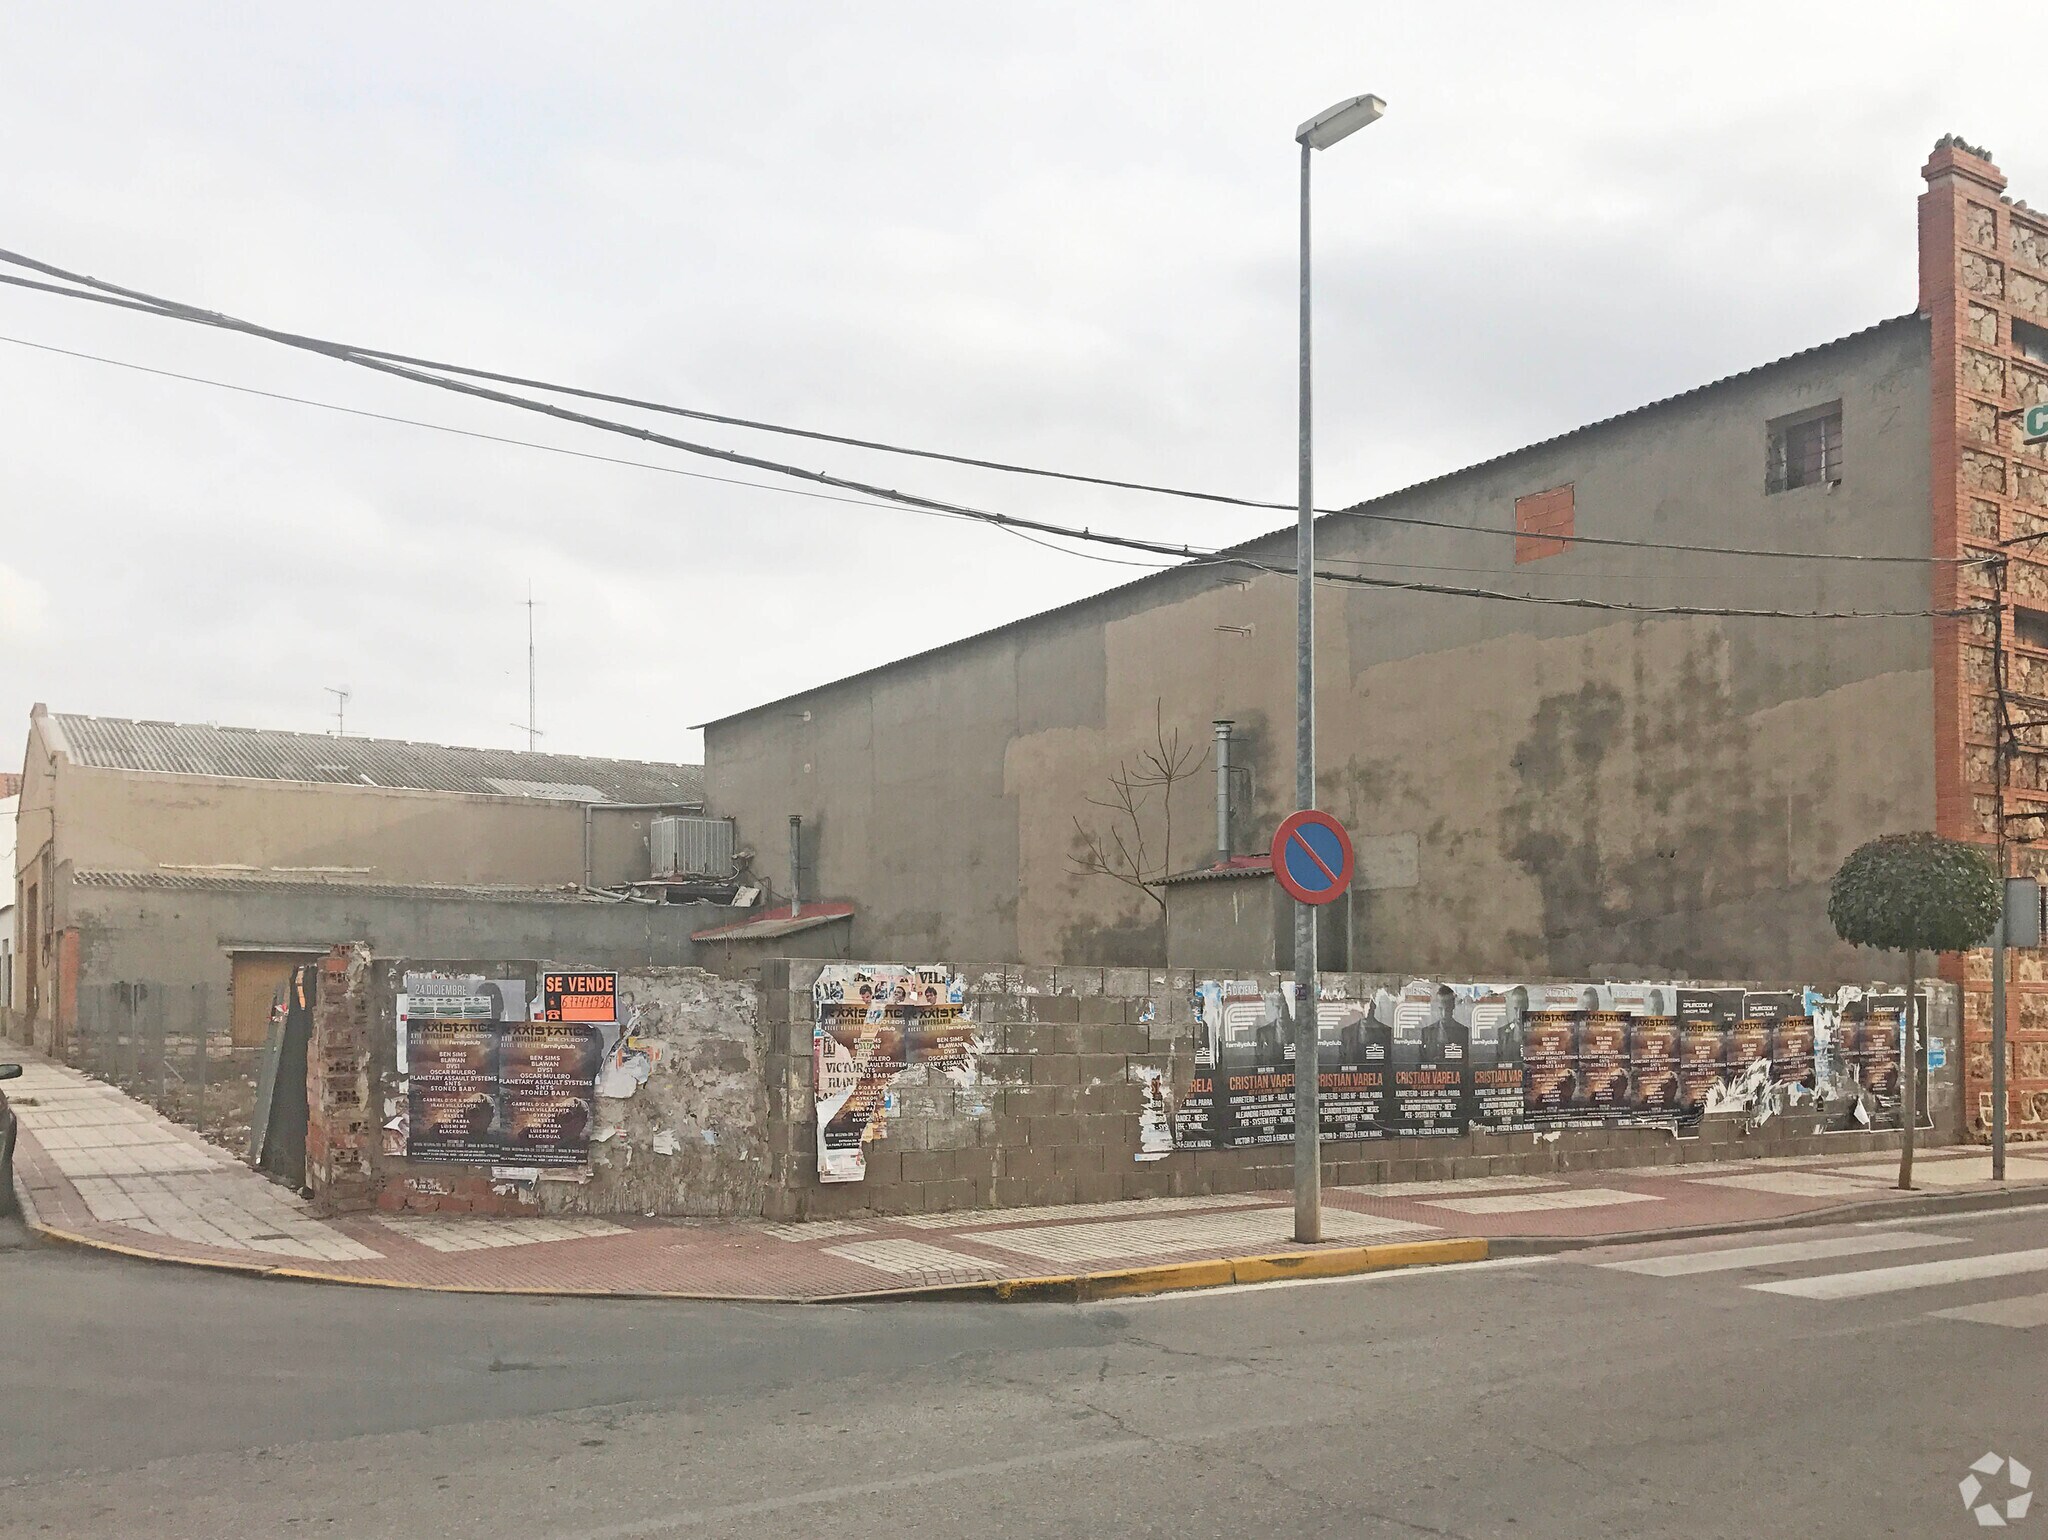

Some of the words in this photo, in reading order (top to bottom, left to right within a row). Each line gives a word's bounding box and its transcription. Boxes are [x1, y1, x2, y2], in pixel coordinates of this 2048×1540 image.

[415, 984, 424, 995] 24
[426, 984, 467, 996] DICIEMBRE
[546, 976, 563, 992] SE
[568, 976, 614, 992] VENDE
[1229, 1075, 1270, 1090] CRISTIAN
[1270, 1073, 1295, 1088] VAREL
[1353, 1072, 1383, 1086] VARELA
[1396, 1072, 1430, 1085] CRISTIAN
[1431, 1071, 1460, 1084] VARELA
[1475, 1071, 1508, 1083] CRISTIAN
